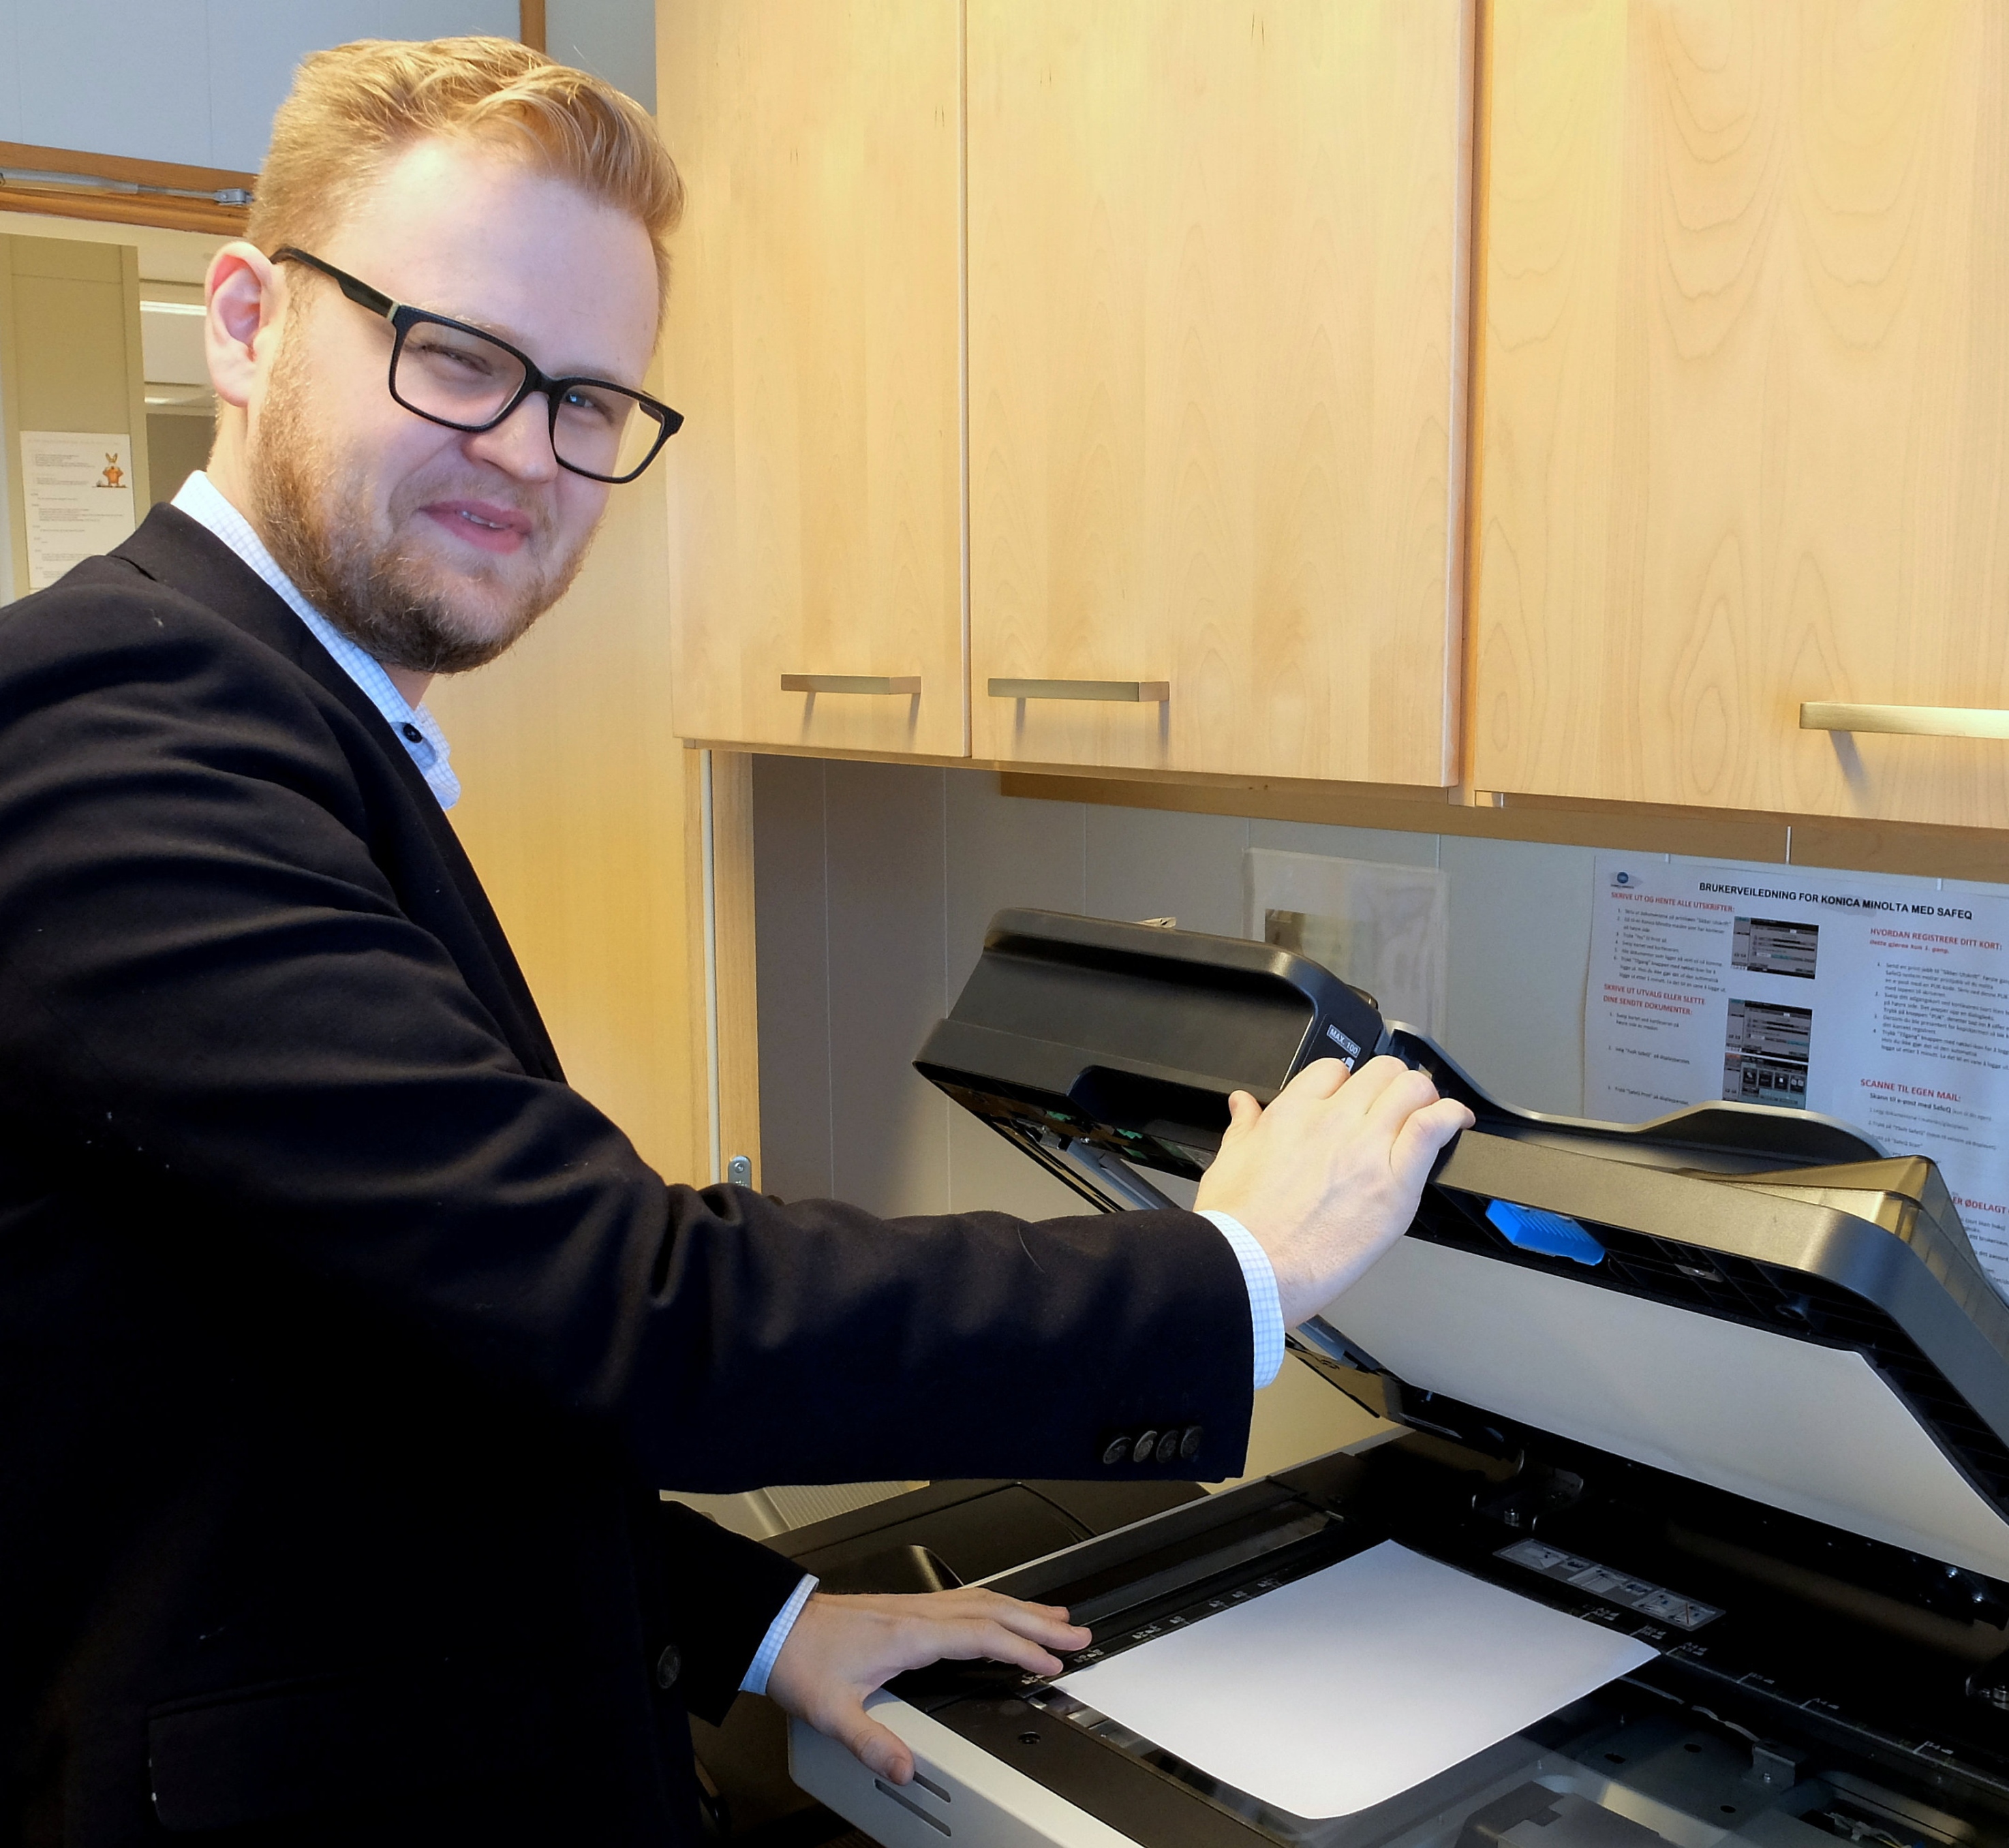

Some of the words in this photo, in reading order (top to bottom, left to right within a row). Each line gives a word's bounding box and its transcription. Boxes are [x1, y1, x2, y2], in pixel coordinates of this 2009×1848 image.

[1611, 891, 1633, 901] SKRIVE
[1644, 895, 1654, 904] OG
[1655, 897, 1676, 906] HENTE
[1677, 899, 1691, 908] ALLE
[1693, 902, 1735, 912] UTSKRIFTER:
[1699, 882, 1797, 901] BRUKERVEILEDNING
[1798, 892, 1818, 903] FOR
[1821, 895, 1860, 908] KONICA
[1862, 899, 1909, 913] MINOLTA
[1911, 905, 1935, 915] MED
[1937, 908, 1972, 920] SAFEQ
[1870, 927, 1910, 940] HVORDAN
[1912, 933, 1958, 945] REGISTRERE
[1960, 938, 1977, 947] DITT
[1979, 940, 2002, 951] KORT:
[1604, 983, 1625, 993] SKRIVE
[1626, 986, 1635, 994] UT
[1636, 988, 1662, 999] UTVALG
[1663, 992, 1682, 1002] ELLER
[1683, 995, 1706, 1005] SLETTE
[1603, 995, 1619, 1004] DINE
[1619, 998, 1643, 1008] SENDTE
[1644, 1001, 1693, 1016] DOKUMENTER:
[1330, 1028, 1345, 1045] MAX.
[1347, 1042, 1358, 1054] 100
[1860, 1078, 1895, 1091] SCANNE
[1897, 1083, 1909, 1094] TIL
[1911, 1086, 1934, 1098] EGEN
[1936, 1090, 1961, 1102] MAIL:
[1869, 1092, 1888, 1100] Skann
[1952, 1196, 1962, 1205] ER
[1965, 1199, 2006, 1214] ØDELAGT
